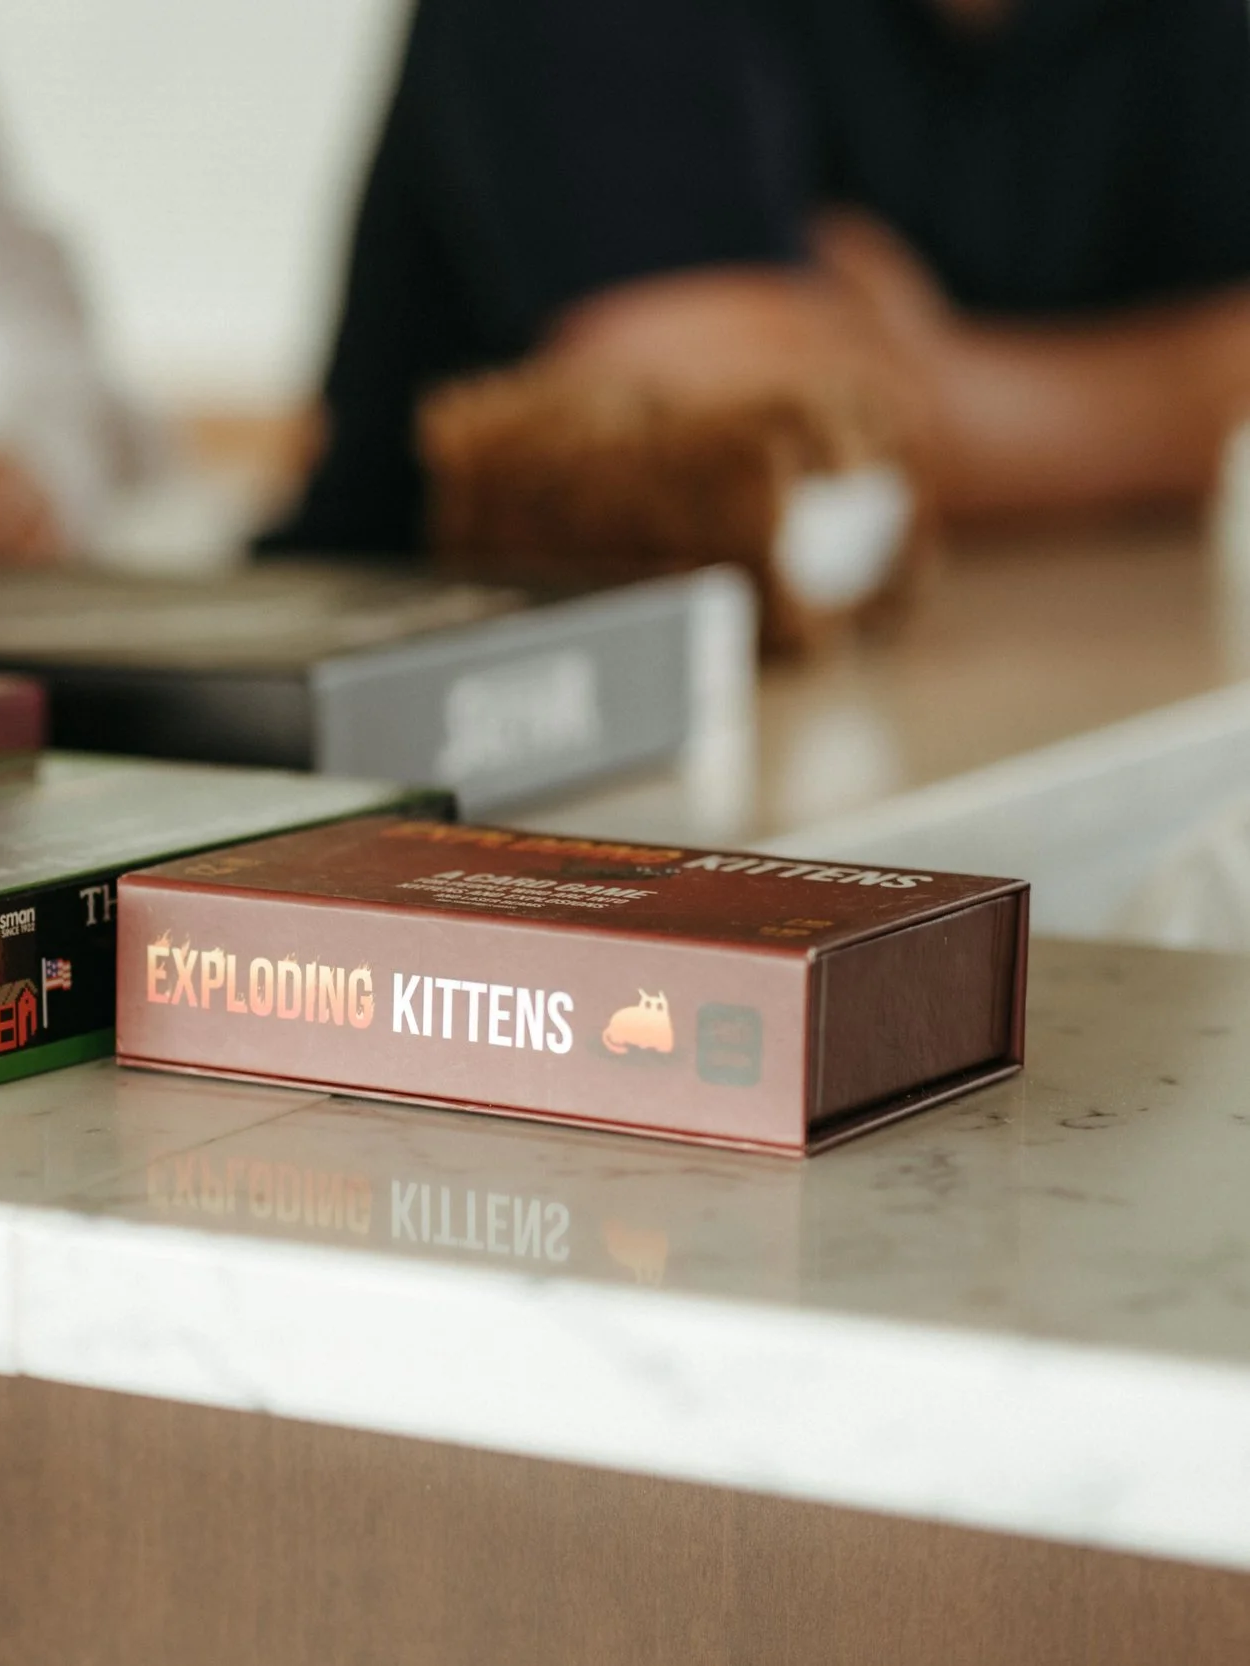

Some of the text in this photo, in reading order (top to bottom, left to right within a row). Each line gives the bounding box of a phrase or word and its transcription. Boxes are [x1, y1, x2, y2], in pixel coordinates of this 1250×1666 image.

[463, 873, 558, 889] CARD
[554, 883, 658, 900] GAME
[682, 854, 935, 890] KITTENS
[79, 884, 117, 927] Th
[146, 937, 575, 1055] EXPLODING KITTENS
